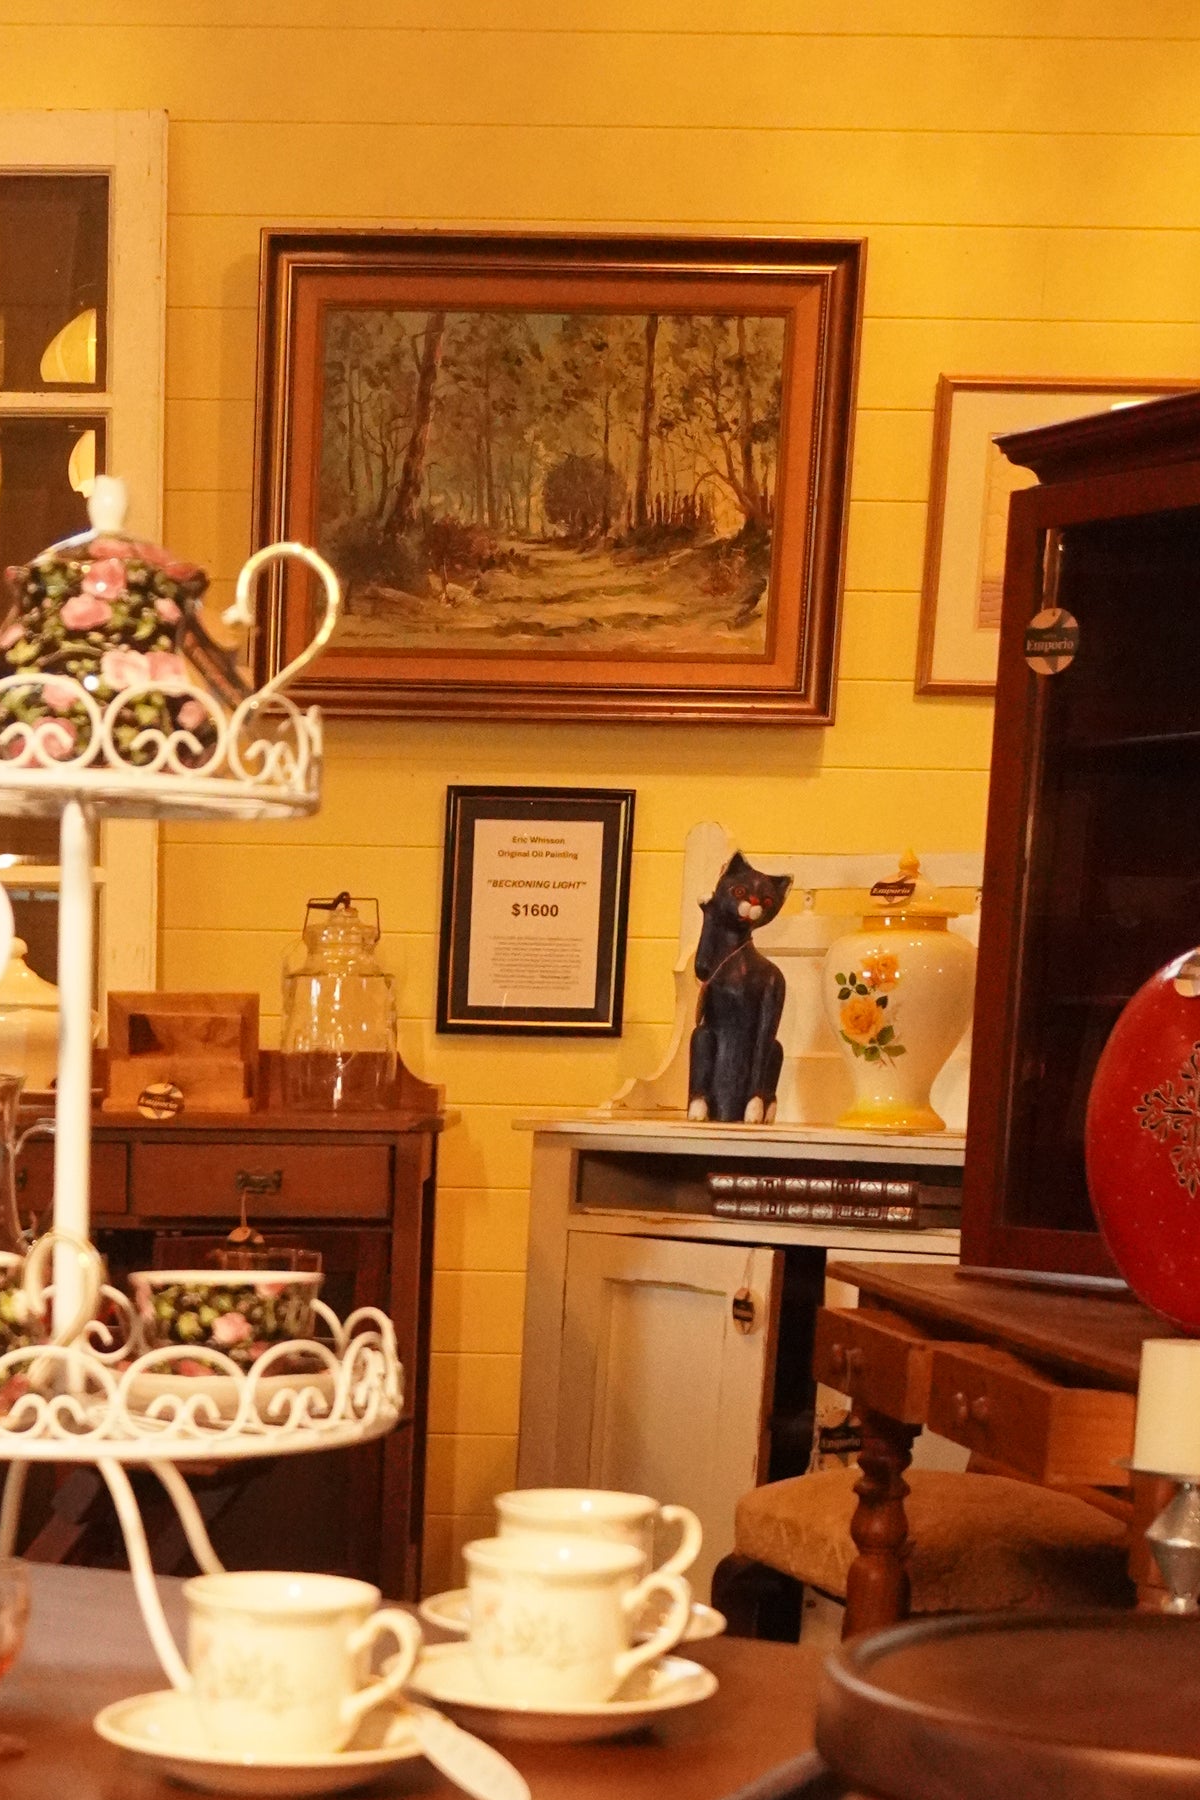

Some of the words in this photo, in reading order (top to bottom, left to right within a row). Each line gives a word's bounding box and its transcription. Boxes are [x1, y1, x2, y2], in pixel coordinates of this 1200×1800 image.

[1026, 638, 1074, 652] Emporio
[511, 835, 528, 844] Eric
[497, 849, 530, 859] Original
[531, 850, 544, 858] Oil
[545, 850, 578, 860] Painting
[510, 902, 559, 918] $1600
